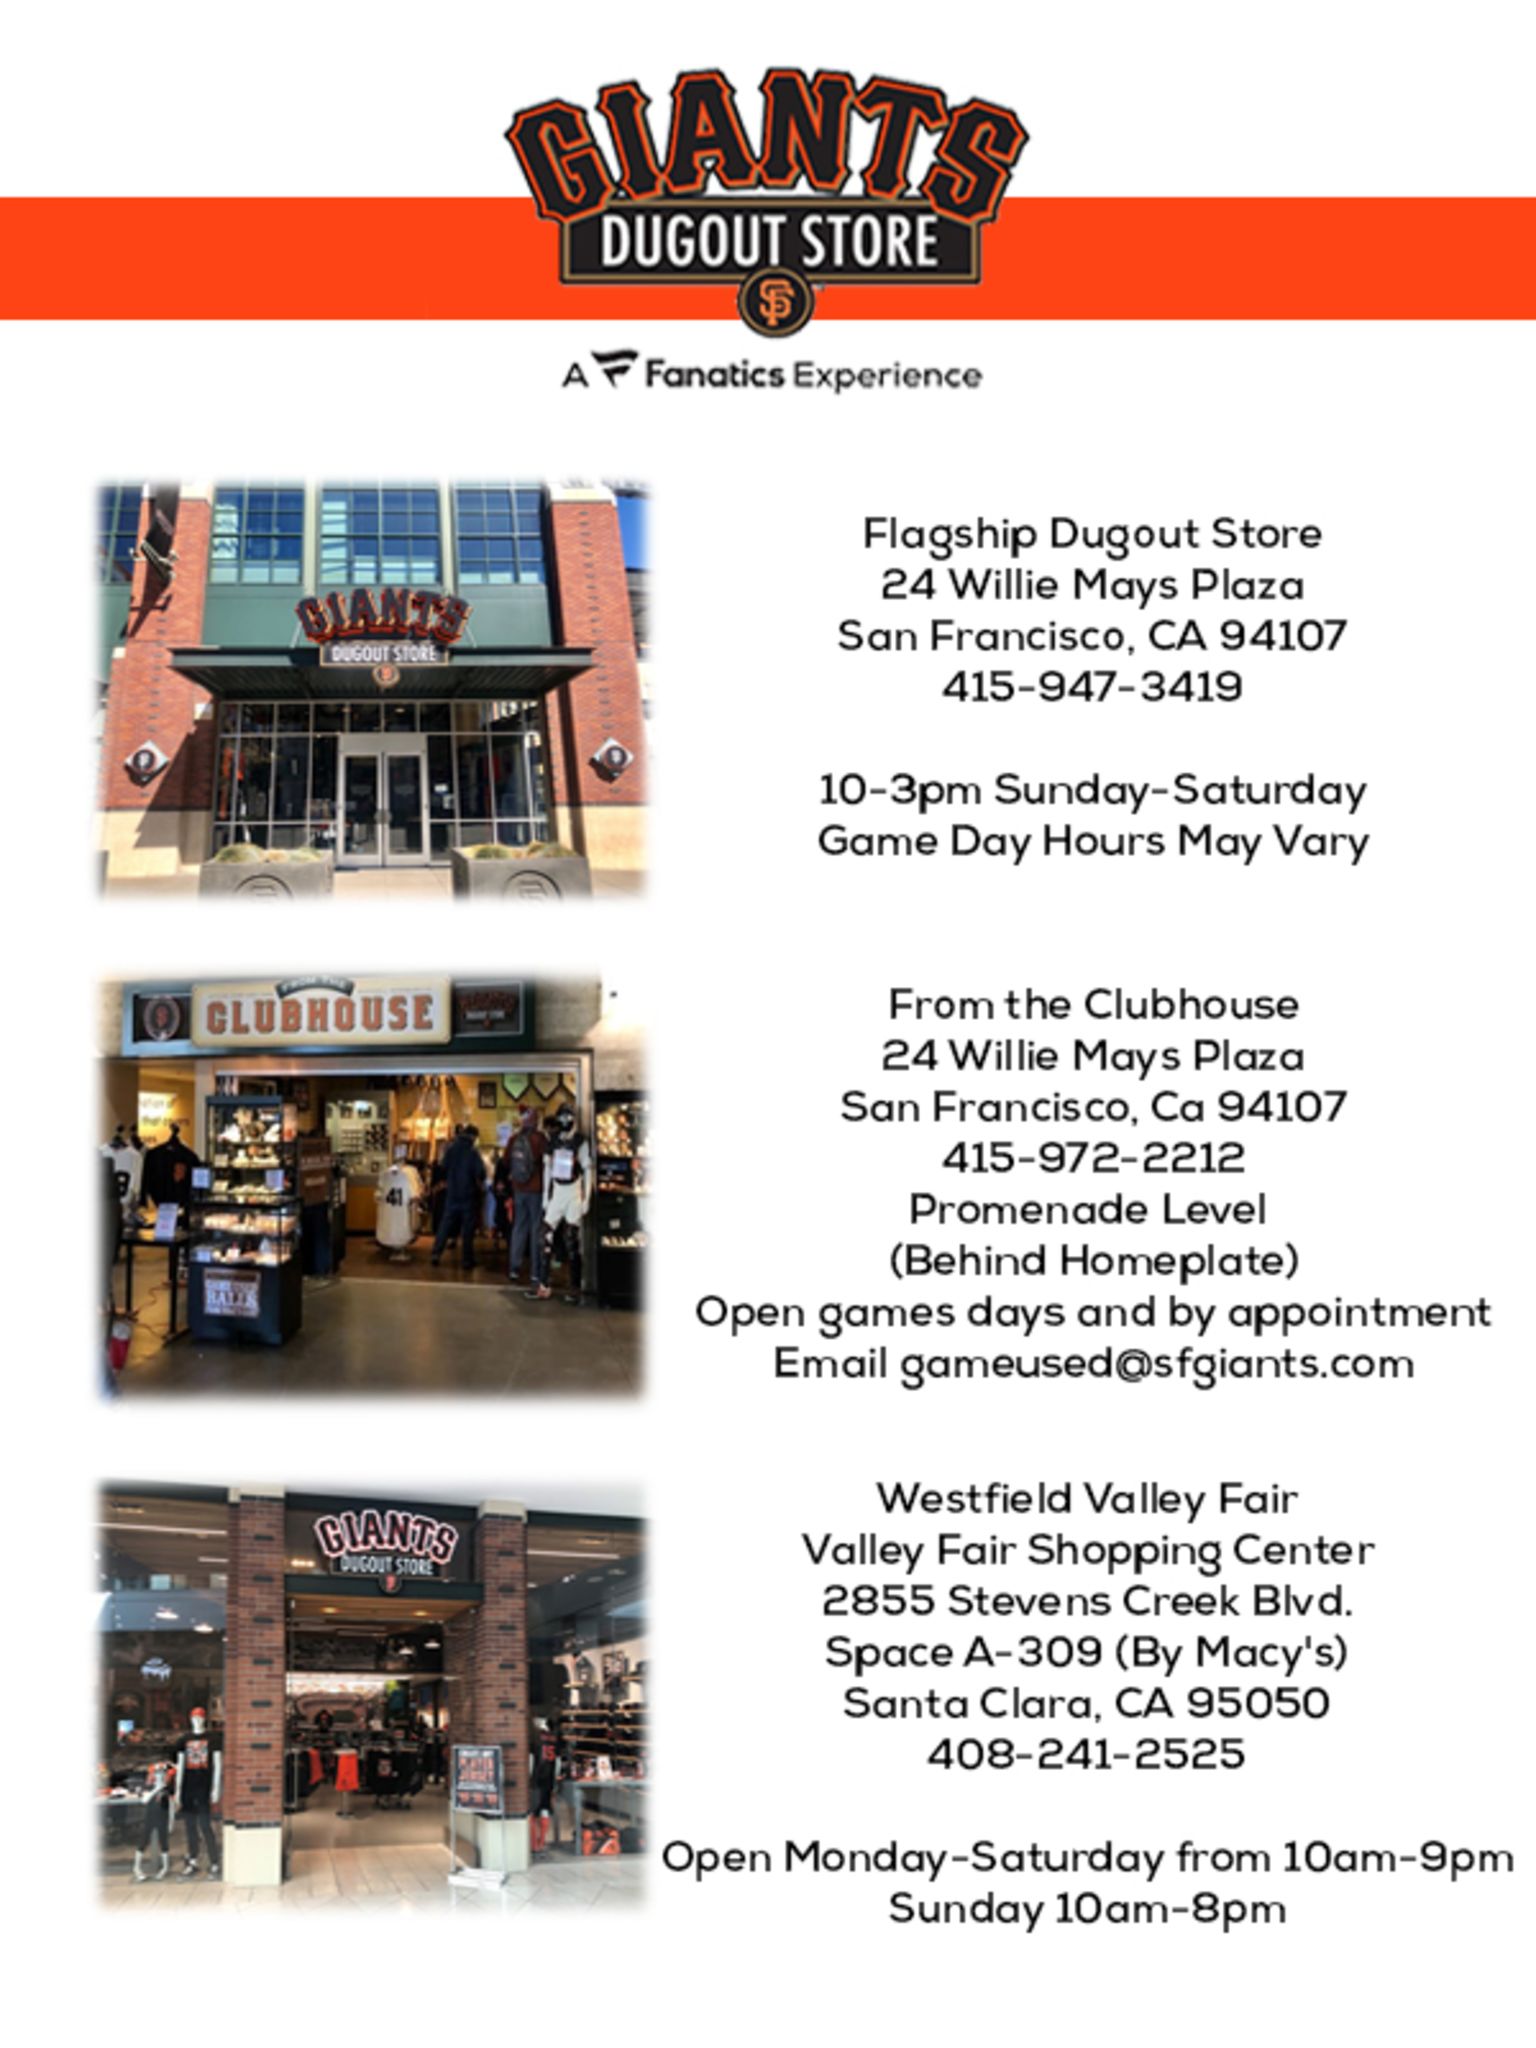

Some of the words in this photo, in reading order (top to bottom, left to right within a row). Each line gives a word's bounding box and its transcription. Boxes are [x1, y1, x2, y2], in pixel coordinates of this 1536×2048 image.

[504, 68, 1030, 223] GIANTS
[602, 215, 787, 267] DUGOUT
[802, 215, 938, 267] STORE
[561, 363, 590, 388] A
[645, 358, 785, 389] Fanatics
[793, 362, 984, 394] Experience
[864, 516, 1038, 562] Flagship
[1051, 516, 1199, 562] Dugout
[1212, 516, 1322, 549] Store
[882, 567, 936, 600] 24
[948, 567, 1059, 600] Willie
[1074, 567, 1179, 610] Mays
[1192, 567, 1304, 600] Plaza
[295, 588, 473, 643] GIANTS
[331, 645, 390, 662] DUGOUT
[394, 645, 437, 662] STORE
[838, 619, 917, 652] San
[931, 619, 1135, 656] Francisco,
[1148, 619, 1207, 651] CA
[1220, 619, 1348, 652] 94107
[942, 670, 1242, 702] 415-947-3419
[821, 772, 981, 815] 10-3pm
[994, 772, 1368, 815] Sunday-Saturday
[818, 823, 938, 856] Game
[951, 823, 1032, 866] Day
[1044, 823, 1166, 856] Hours
[1179, 823, 1263, 866] May
[1272, 824, 1370, 866] Vary
[206, 994, 434, 1035] CLUBHOUSE
[890, 987, 994, 1020] From
[1004, 987, 1071, 1020] the
[1084, 987, 1299, 1020] Clubhouse
[882, 1038, 938, 1071] 24
[948, 1038, 1059, 1071] Willie
[1074, 1038, 1181, 1081] Mays
[1194, 1038, 1304, 1071] Plaza
[841, 1090, 920, 1123] San
[933, 1090, 1138, 1126] Francisco,
[1151, 1090, 1204, 1123] Ca
[1218, 1090, 1348, 1123] 94107
[942, 1141, 1245, 1174] 415-972-2212
[386, 1187, 403, 1207] 41
[910, 1192, 1148, 1225] Promenade
[1163, 1192, 1266, 1225] Level
[890, 1242, 1046, 1280] (Behind
[1061, 1242, 1299, 1286] Homeplate)
[695, 1294, 805, 1337] Open
[818, 1302, 956, 1340] games
[967, 1295, 1066, 1337] days
[1077, 1294, 1155, 1327] and
[1169, 1294, 1216, 1337] by
[1228, 1296, 1491, 1337] appointment
[775, 1346, 887, 1379] Email
[900, 1346, 1414, 1391] gameused@sfgiants.com
[876, 1481, 1071, 1514] Westfield
[1083, 1481, 1206, 1524] Valley
[1220, 1481, 1299, 1514] Fair
[314, 1509, 459, 1565] GIANTS
[801, 1533, 925, 1575] Valley
[938, 1533, 1017, 1566] Fair
[1028, 1532, 1222, 1578] Shopping
[1233, 1533, 1376, 1565] Center
[340, 1555, 393, 1574] DUGOUT
[395, 1557, 434, 1576] STORE
[823, 1584, 935, 1616] 2855
[948, 1584, 1112, 1616] Stevens
[1123, 1584, 1240, 1616] Creek
[1253, 1584, 1352, 1617] Blvd.
[826, 1635, 954, 1678] Space
[963, 1635, 1102, 1668] A-309
[1115, 1634, 1183, 1678] (By
[1197, 1634, 1347, 1678] Macy's)
[843, 1686, 968, 1719] Santa
[979, 1686, 1102, 1723] Clara,
[1115, 1686, 1174, 1719] CA
[1187, 1686, 1330, 1719] 95050
[927, 1737, 1245, 1771] 408-241-2525
[662, 1840, 771, 1882] Open
[785, 1840, 1165, 1883] Monday-Saturday
[1176, 1840, 1271, 1872] from
[1284, 1840, 1514, 1882] 10am-9pm
[889, 1891, 1045, 1934] Sunday
[1056, 1891, 1286, 1934] 10am-8pm
